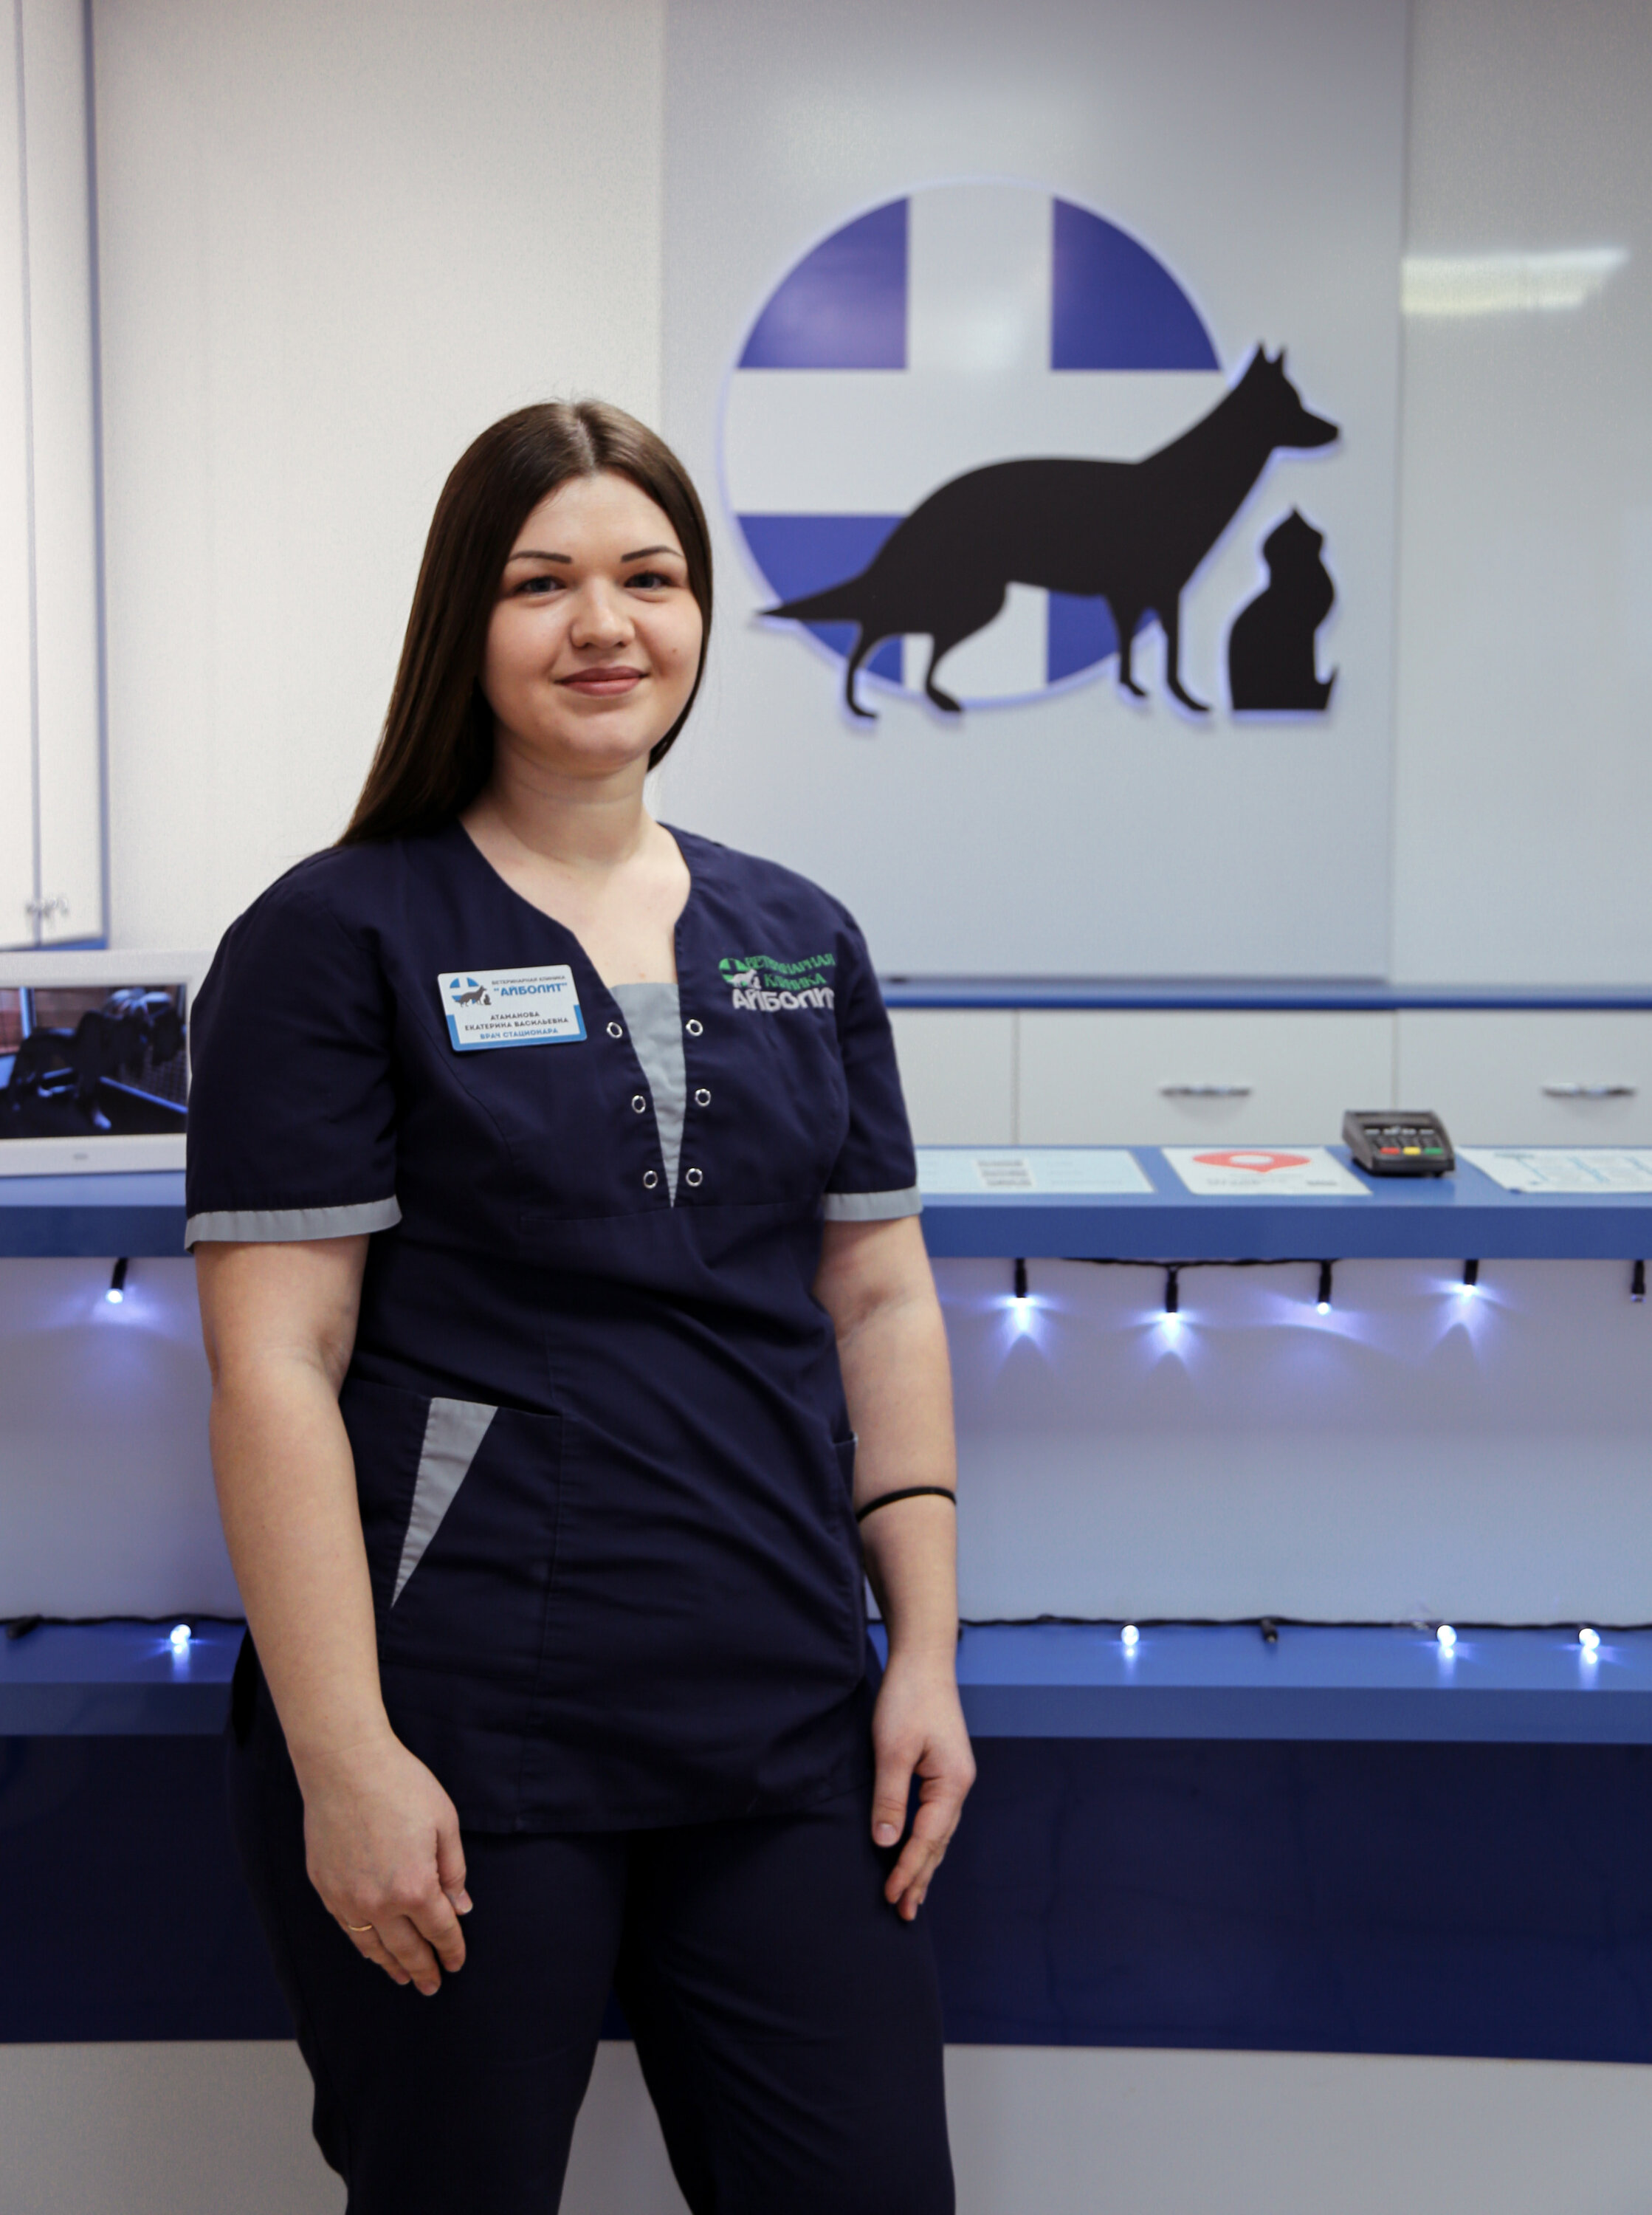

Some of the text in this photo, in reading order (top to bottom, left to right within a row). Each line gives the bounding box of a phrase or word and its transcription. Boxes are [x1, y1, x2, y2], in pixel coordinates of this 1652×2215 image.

[491, 1012, 540, 1020] АТАМАНОВА
[465, 1018, 568, 1031] ЕКАТЕРИНА ВАСИЛЬЕВНА
[503, 1028, 558, 1037] СТАЦИОНАРА
